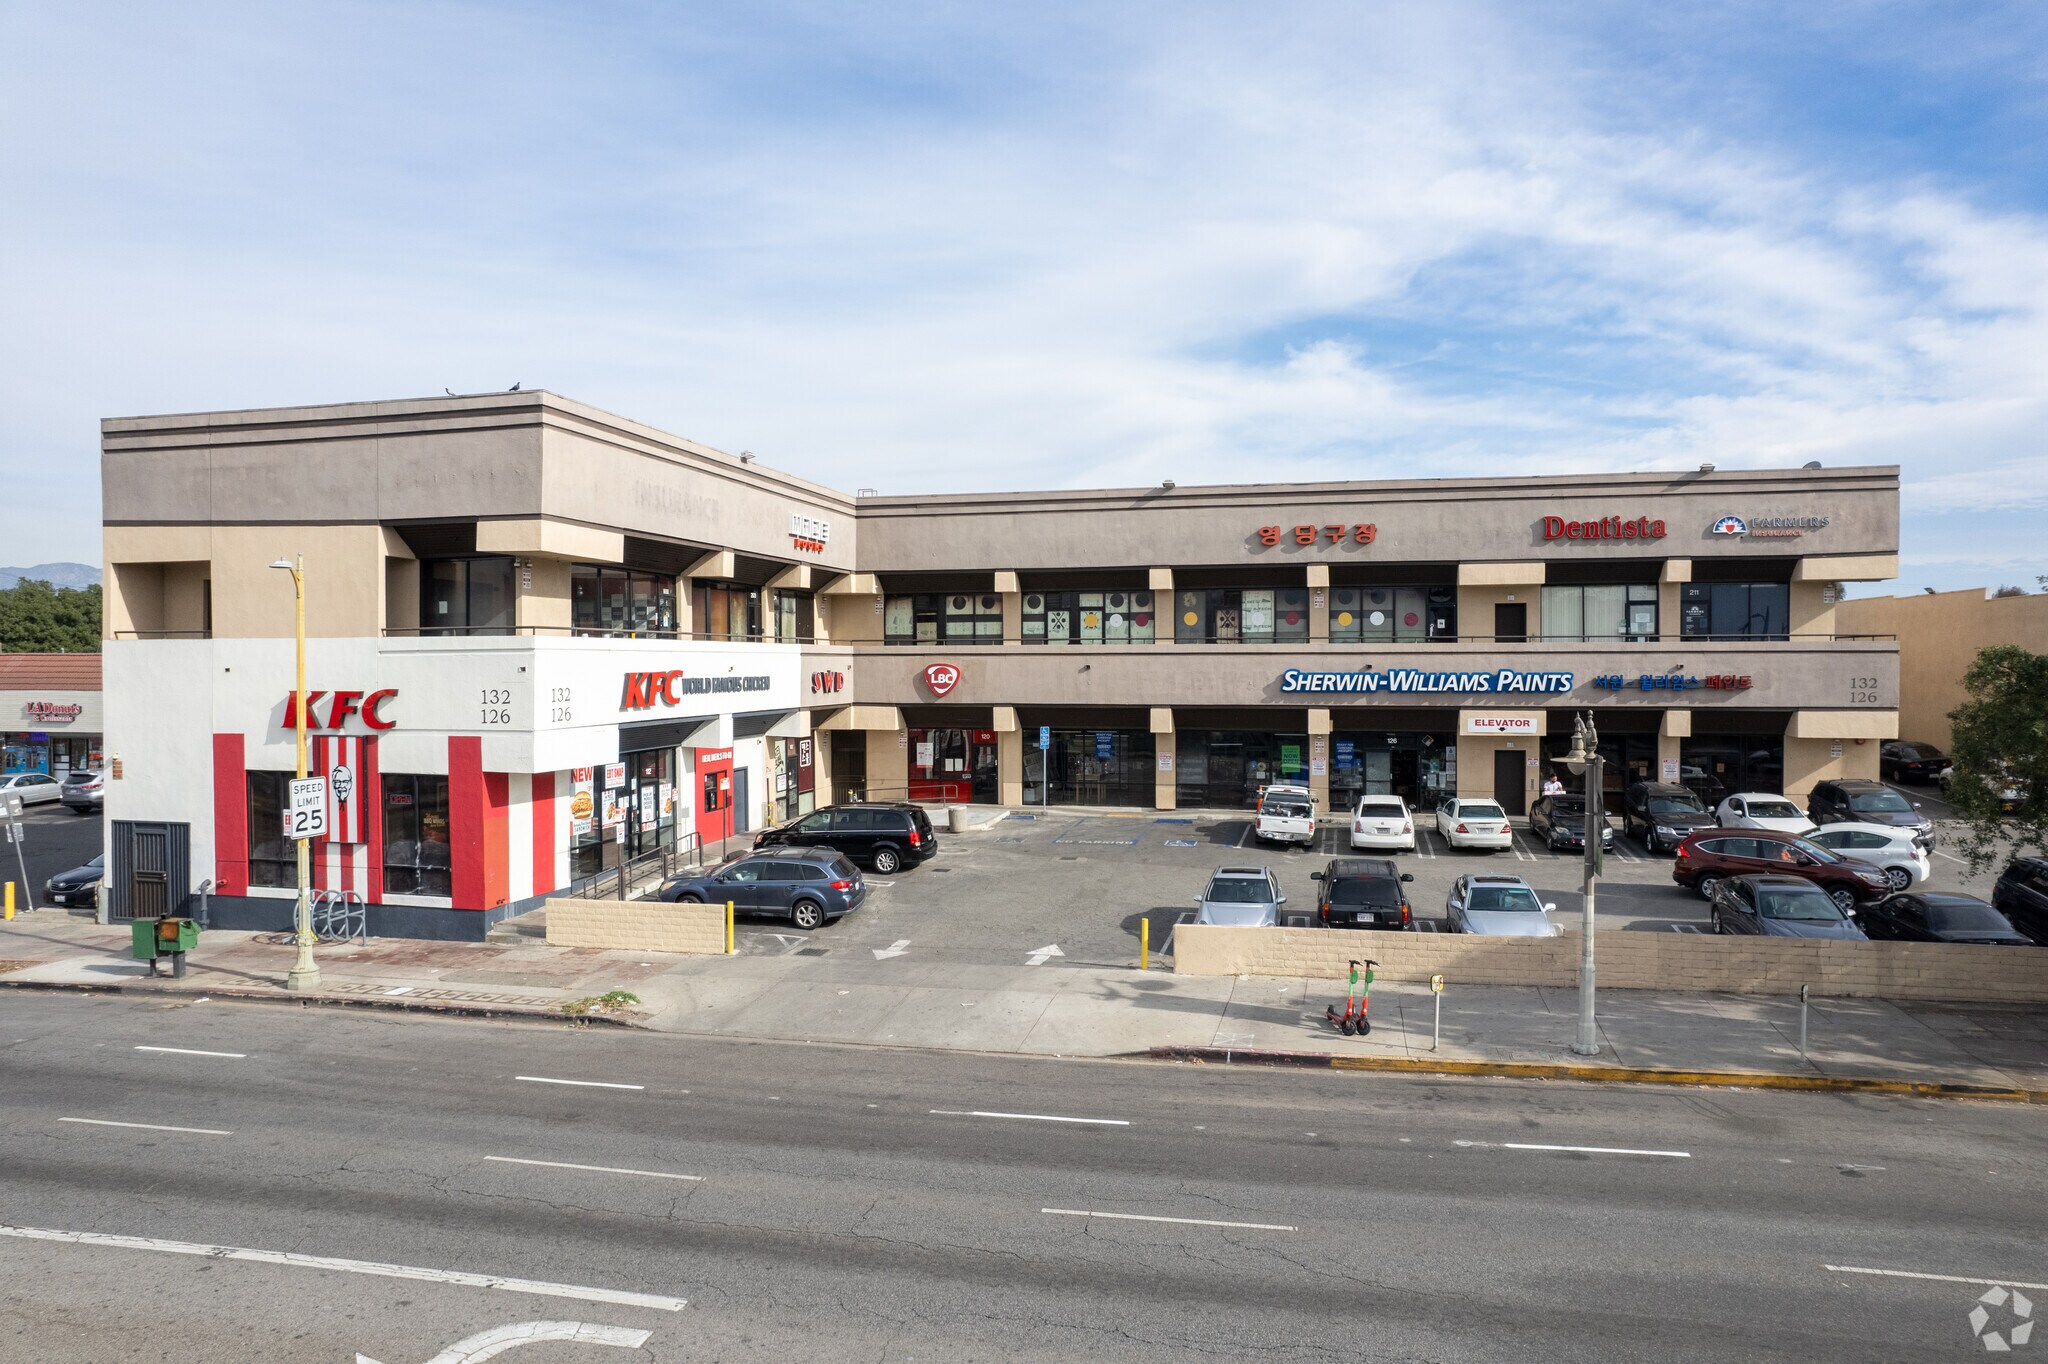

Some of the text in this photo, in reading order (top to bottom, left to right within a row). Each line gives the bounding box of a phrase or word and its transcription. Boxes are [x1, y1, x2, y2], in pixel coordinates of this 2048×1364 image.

[1543, 515, 1667, 540] Dentista
[1752, 517, 1830, 528] FARMERS
[1752, 529, 1804, 538] INSURANCE
[682, 675, 771, 695] WORLD FAMOUS CHICKEN
[812, 671, 844, 694] SWD
[931, 673, 954, 684] LBC
[1281, 670, 1573, 692] SHERWIN-WILLIAMS PAINTS
[1705, 674, 1754, 691] 페인트
[1850, 677, 1878, 689] 132
[481, 689, 511, 704] 132
[551, 687, 571, 702] 132
[622, 669, 683, 709] KFC
[1850, 692, 1878, 703] 126
[281, 688, 399, 730] KFC
[481, 709, 511, 724] 126
[551, 707, 572, 722] 126
[1474, 719, 1531, 727] ELEVATOR
[570, 766, 593, 784] NEW
[293, 783, 323, 795] SPEED
[297, 796, 320, 807] LIMIT
[295, 808, 323, 832] 25
